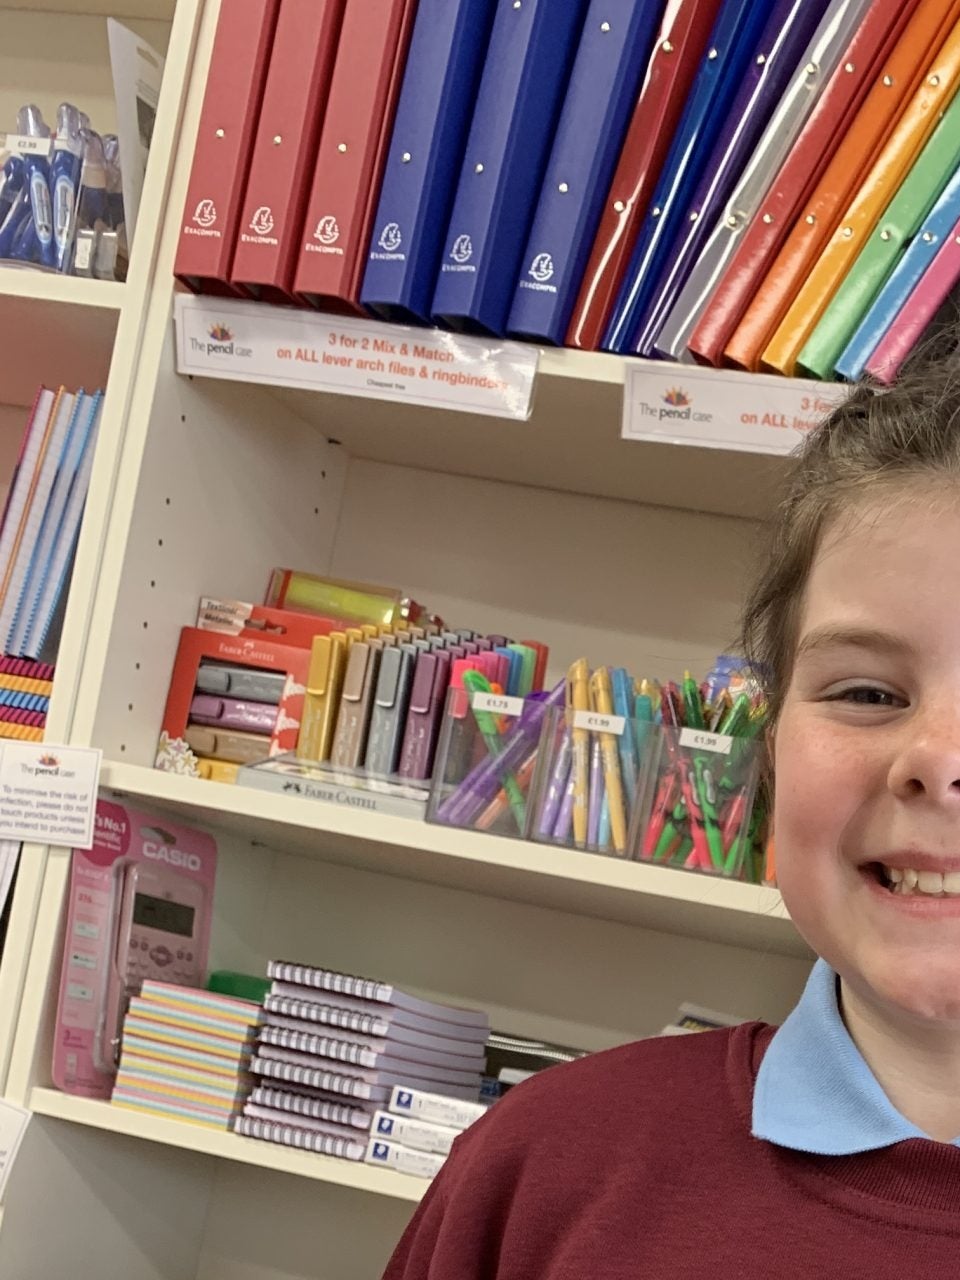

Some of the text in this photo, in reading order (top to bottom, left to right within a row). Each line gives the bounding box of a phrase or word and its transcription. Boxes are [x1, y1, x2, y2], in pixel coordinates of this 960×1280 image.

[206, 339, 234, 356] pencil
[328, 333, 455, 362] 3 for Mix & Match
[277, 347, 429, 378] on ALL lever arch files &
[659, 405, 691, 423] pencil
[740, 412, 789, 428] on ALL
[24, 810, 58, 821] products
[50, 825, 85, 836] purchase
[104, 817, 126, 833] No.1
[143, 841, 200, 871] CASIO
